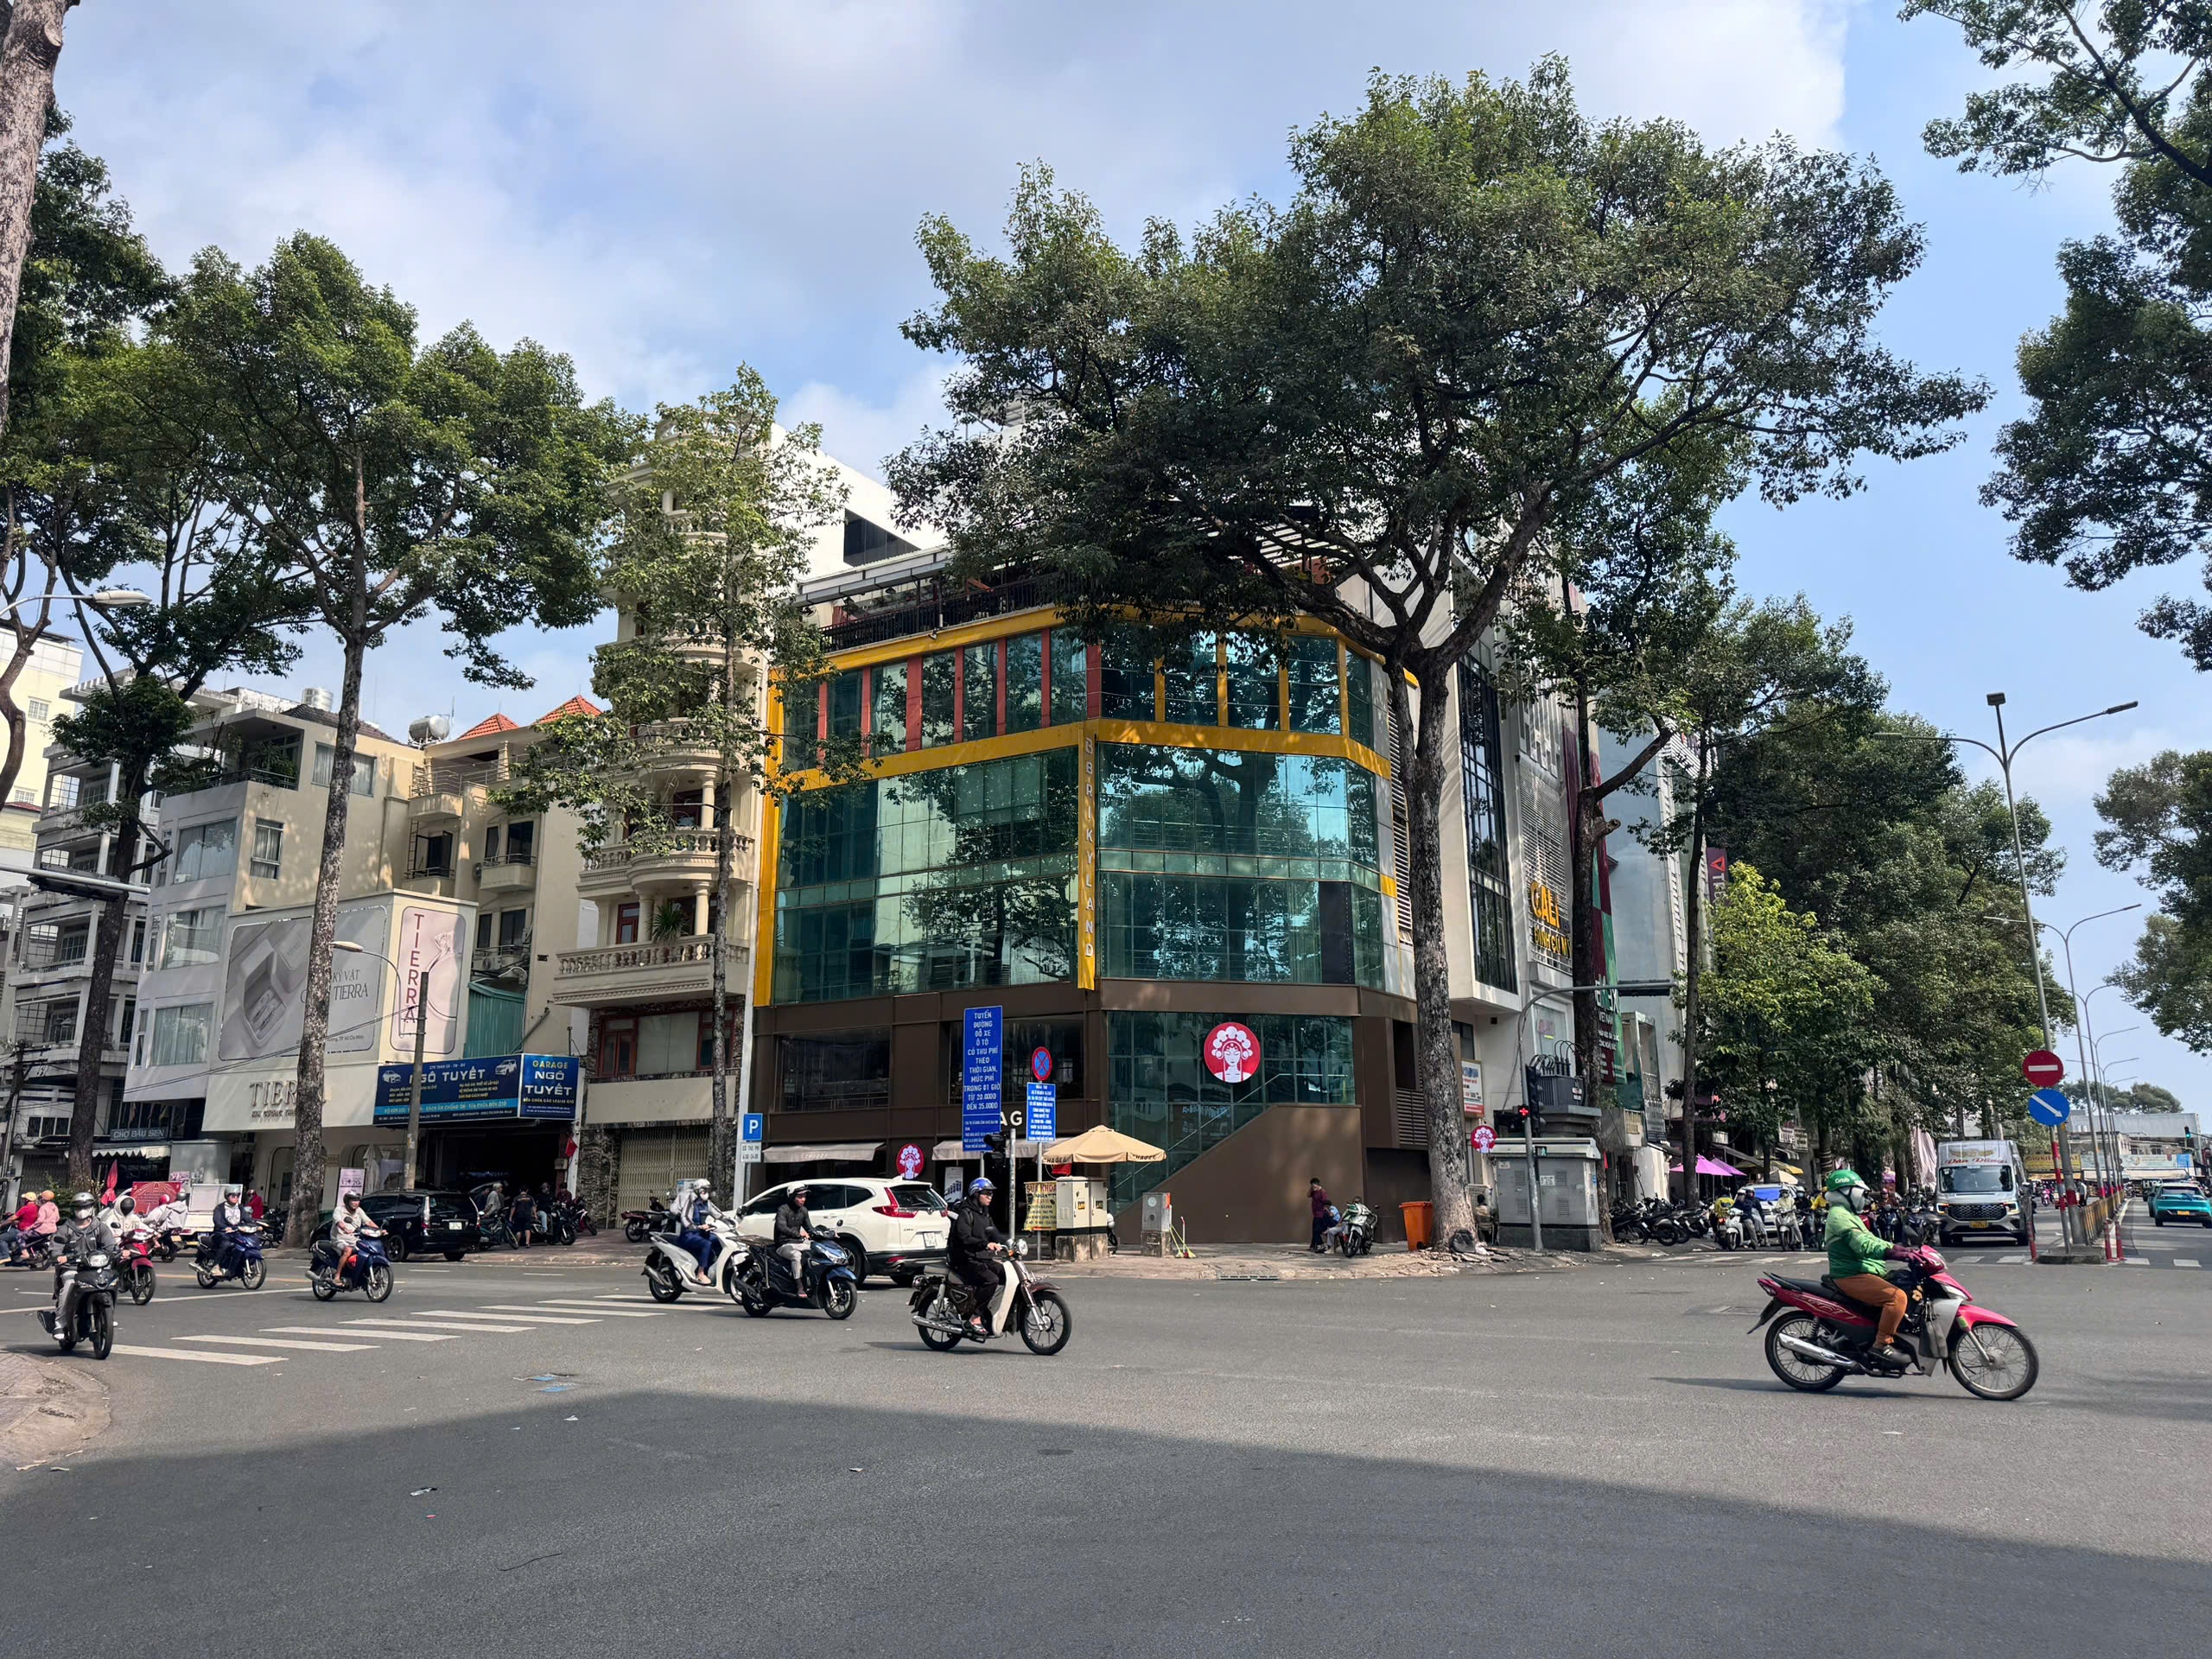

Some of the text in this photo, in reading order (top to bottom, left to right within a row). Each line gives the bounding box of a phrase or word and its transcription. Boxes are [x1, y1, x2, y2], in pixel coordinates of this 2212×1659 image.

[405, 913, 424, 1023] TIERRA
[334, 982, 368, 1001] TIERRA
[532, 1060, 568, 1069] GARAGE
[410, 1066, 486, 1084] GÔ TUYẾT
[535, 1071, 564, 1080] NGÔ
[524, 1083, 572, 1096] TUYẾT
[749, 1119, 758, 1134] P
